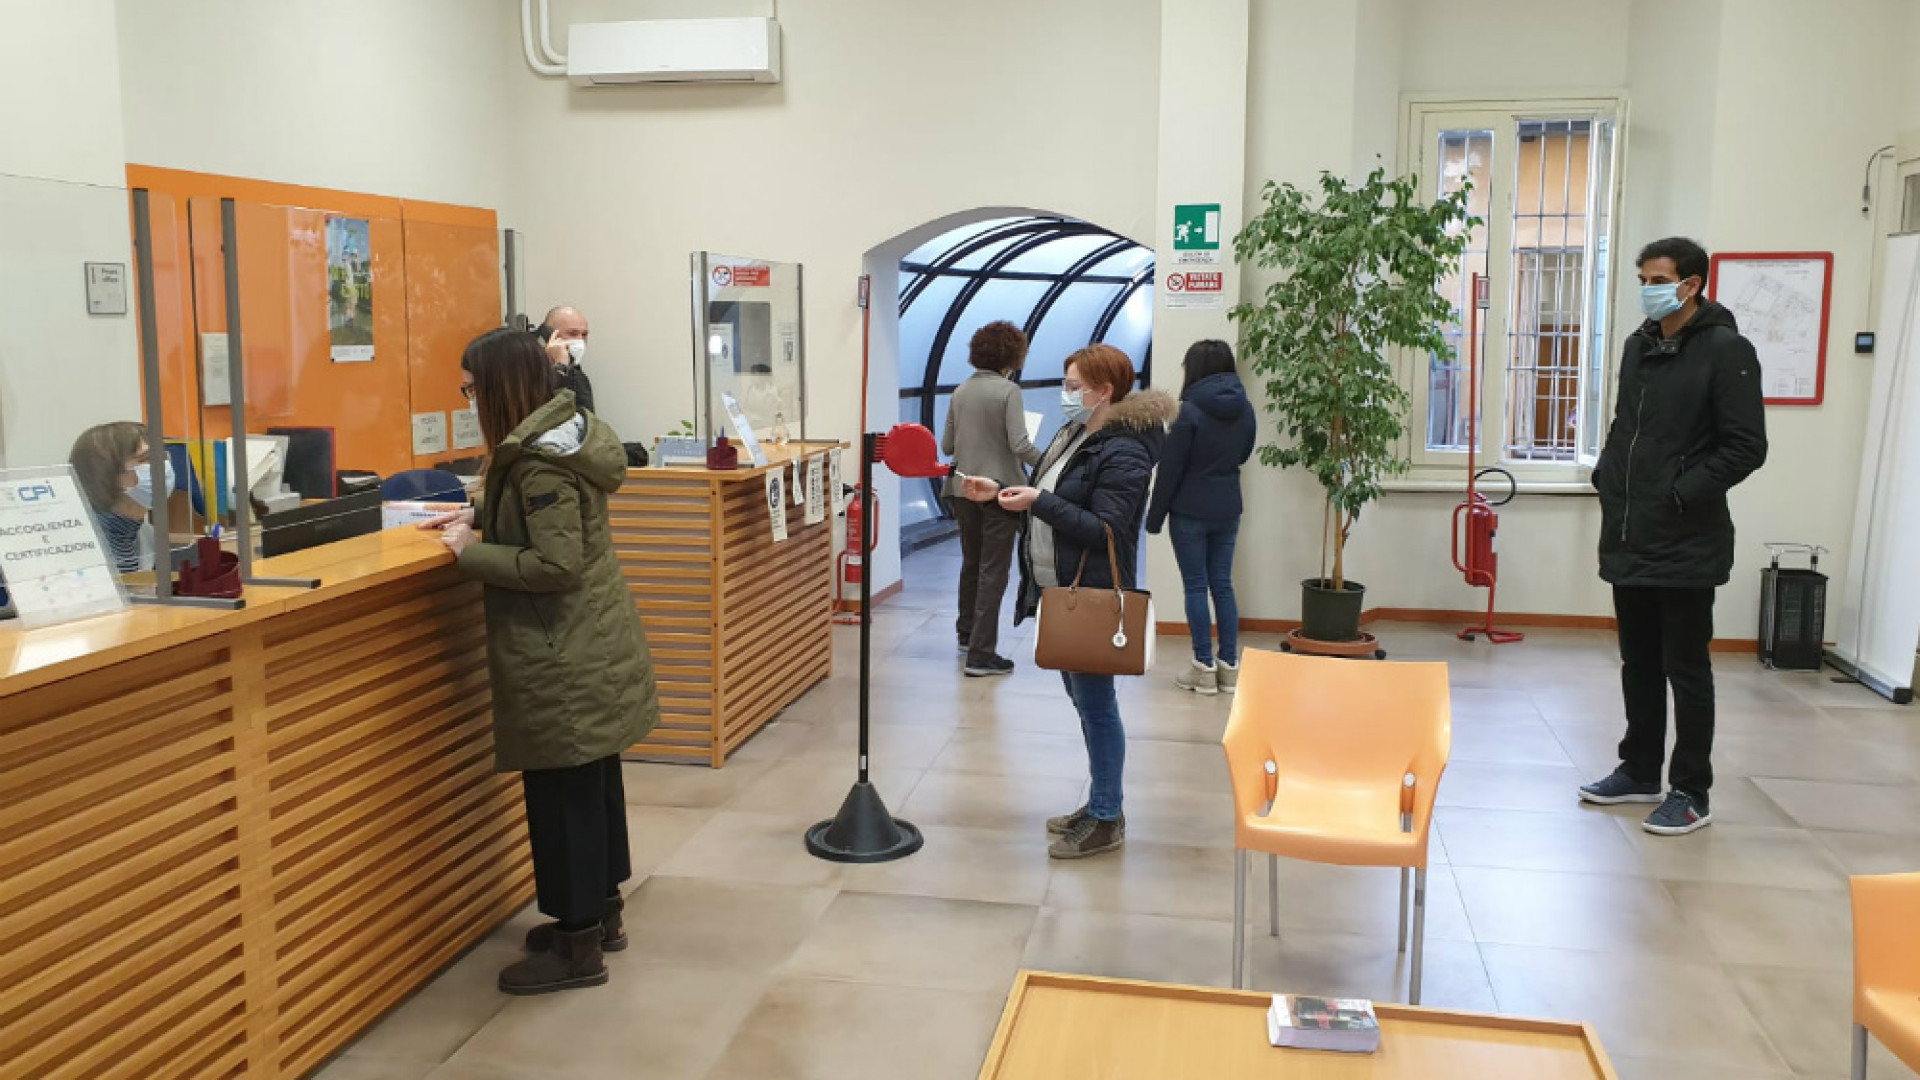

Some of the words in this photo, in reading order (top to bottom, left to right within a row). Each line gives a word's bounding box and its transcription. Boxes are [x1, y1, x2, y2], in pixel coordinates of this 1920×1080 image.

[0, 519, 82, 535] ACCOGLIENZA
[42, 535, 50, 543] E
[5, 541, 95, 560] CERTIFICAZIONI
